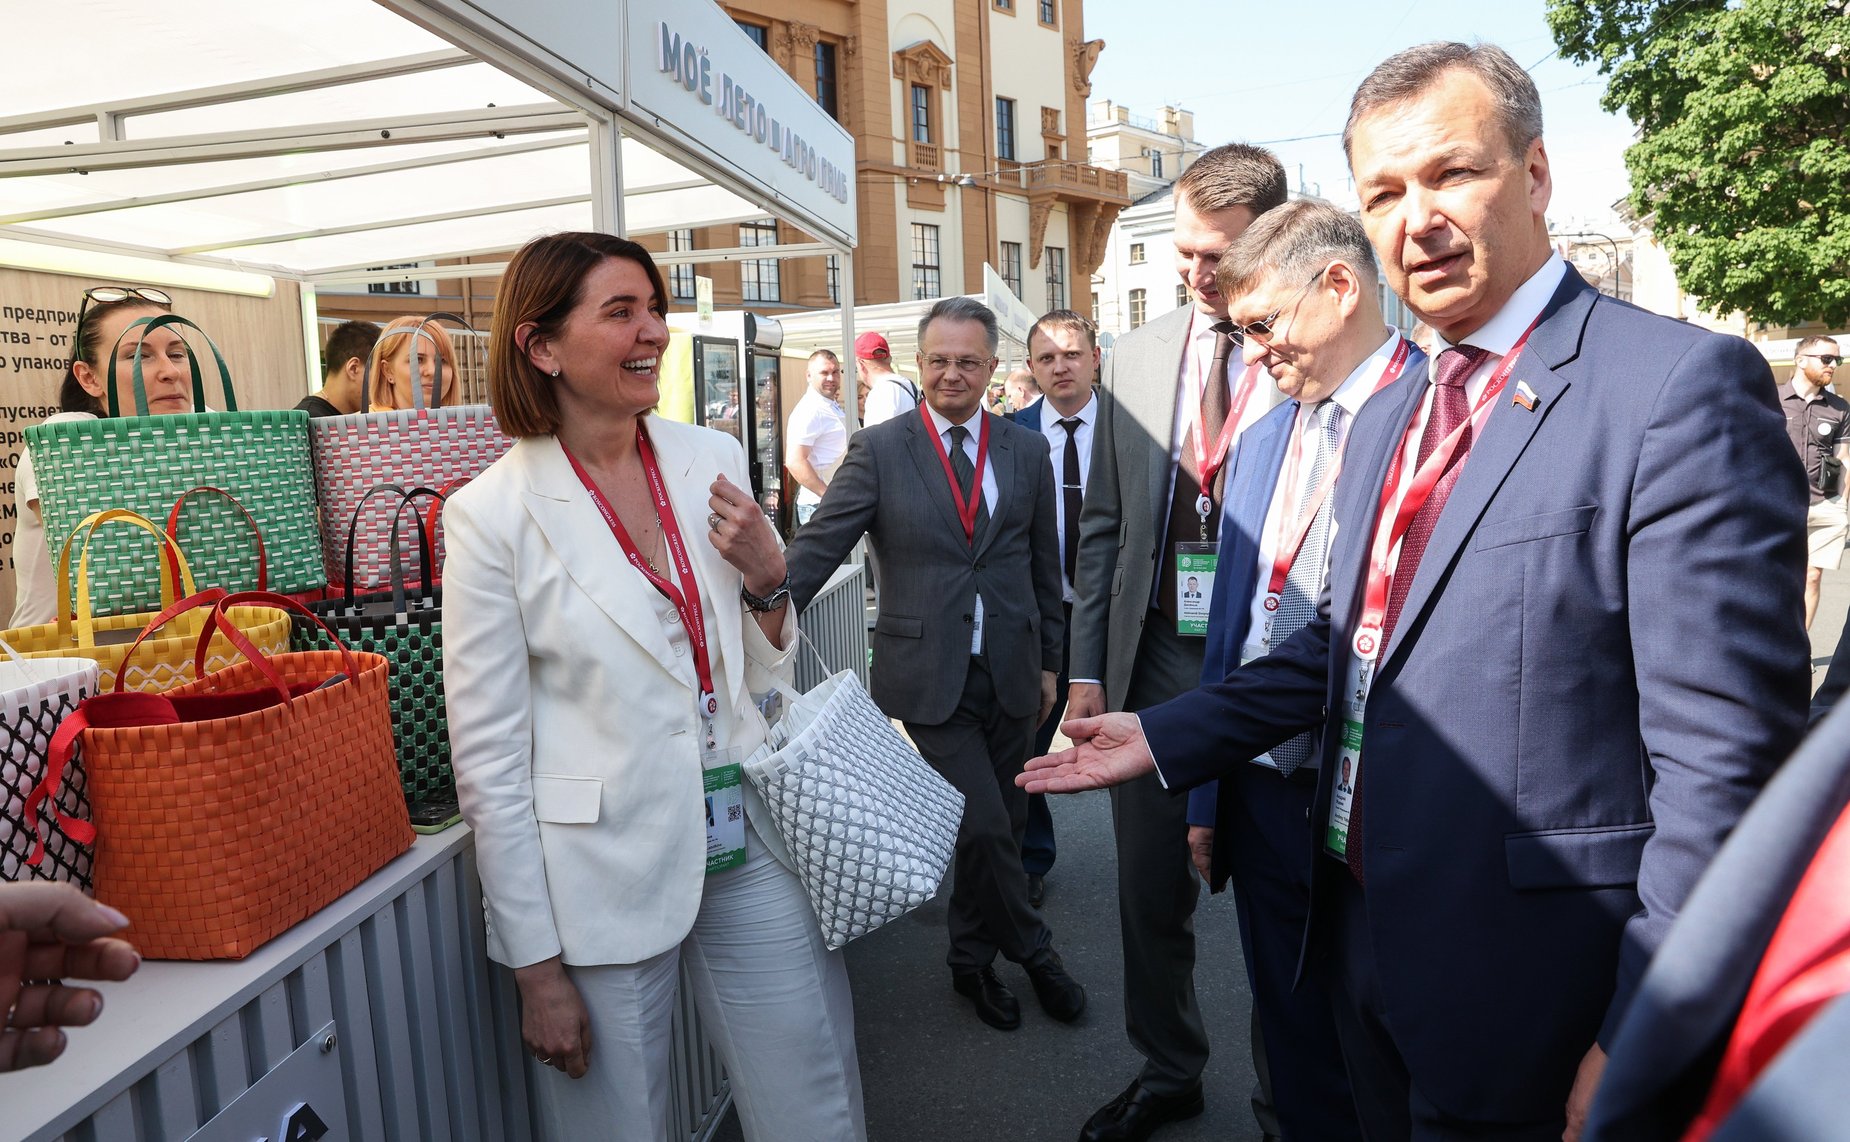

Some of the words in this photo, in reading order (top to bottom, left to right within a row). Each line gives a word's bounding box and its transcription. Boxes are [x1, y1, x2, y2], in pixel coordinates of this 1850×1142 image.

[658, 21, 713, 106] МОЁ
[717, 72, 767, 144] ЛЕТО
[781, 126, 817, 181] АГРО
[50, 334, 67, 346] от
[592, 494, 617, 528] ROSCONGRESS
[671, 532, 688, 570] ROSCONGRESS
